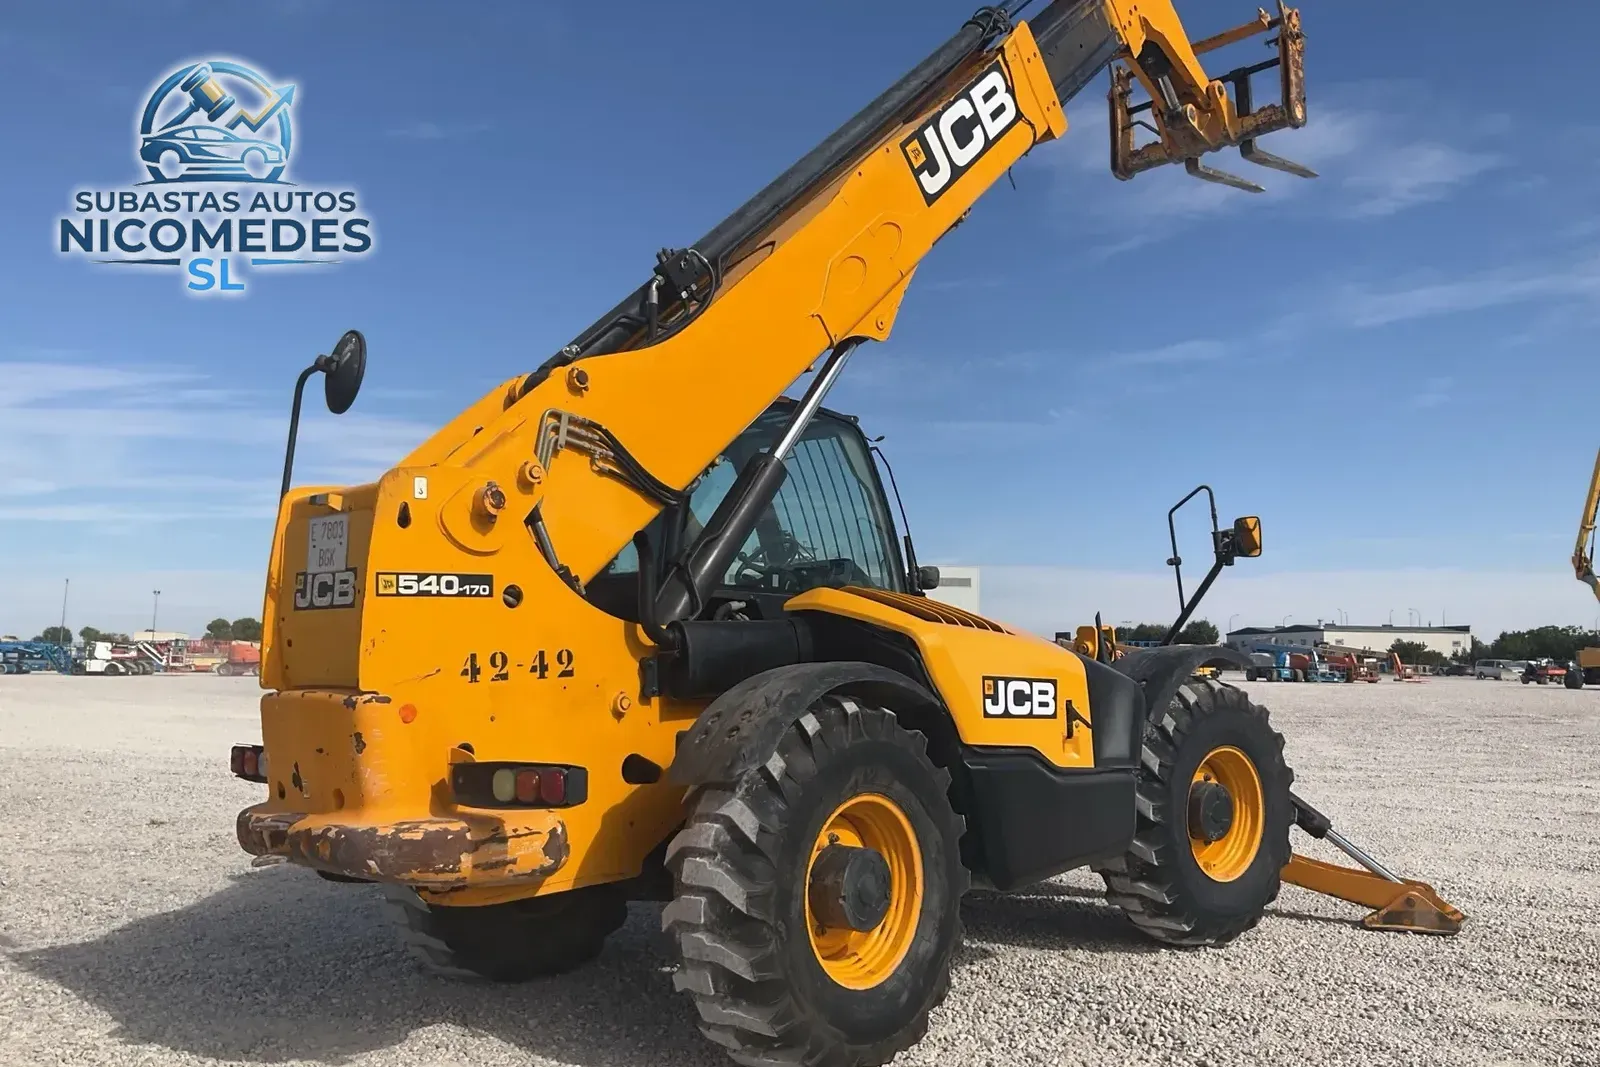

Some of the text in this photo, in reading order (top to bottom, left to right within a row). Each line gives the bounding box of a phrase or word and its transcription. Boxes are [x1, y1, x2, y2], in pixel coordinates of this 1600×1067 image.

[919, 71, 1017, 195] JCB
[322, 520, 344, 540] 7803
[319, 547, 336, 568] BGK
[295, 571, 356, 608] JCB
[397, 574, 490, 596] 540-170
[984, 680, 1056, 716] JCB
